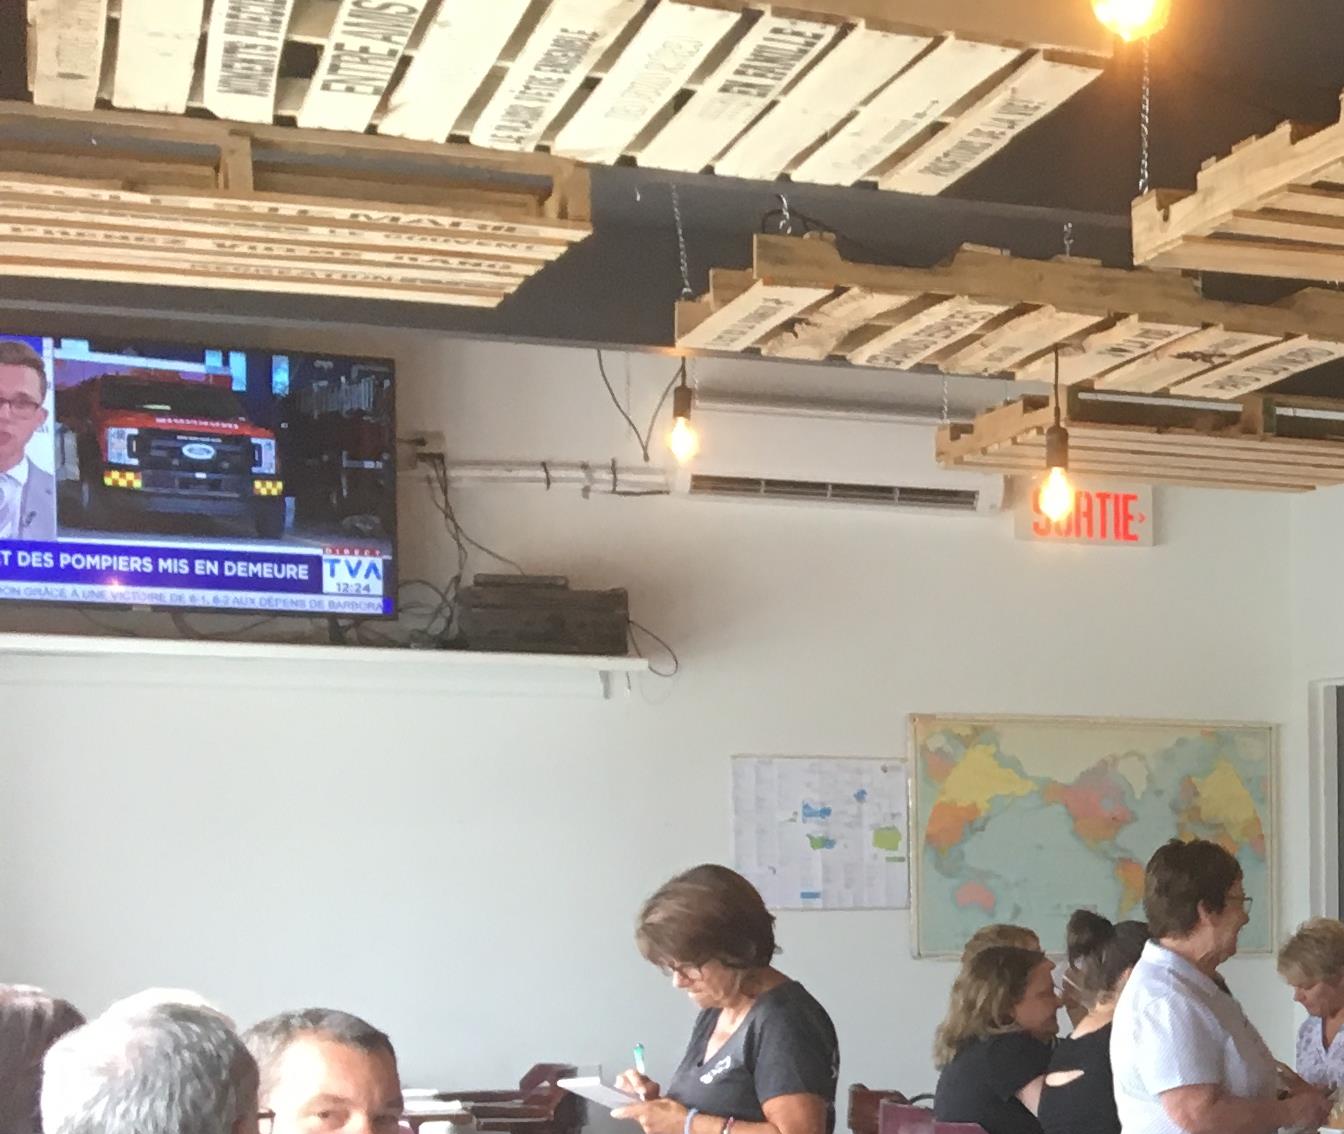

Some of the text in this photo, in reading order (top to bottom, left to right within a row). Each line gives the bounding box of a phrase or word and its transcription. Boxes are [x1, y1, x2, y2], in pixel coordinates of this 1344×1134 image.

[17, 550, 55, 568] DES
[60, 552, 154, 573] POMPIERS
[158, 557, 190, 575] MIS
[194, 559, 219, 576] EN
[224, 560, 310, 581] DEMEURE
[323, 557, 383, 581] TVA
[335, 581, 372, 595] 12:24
